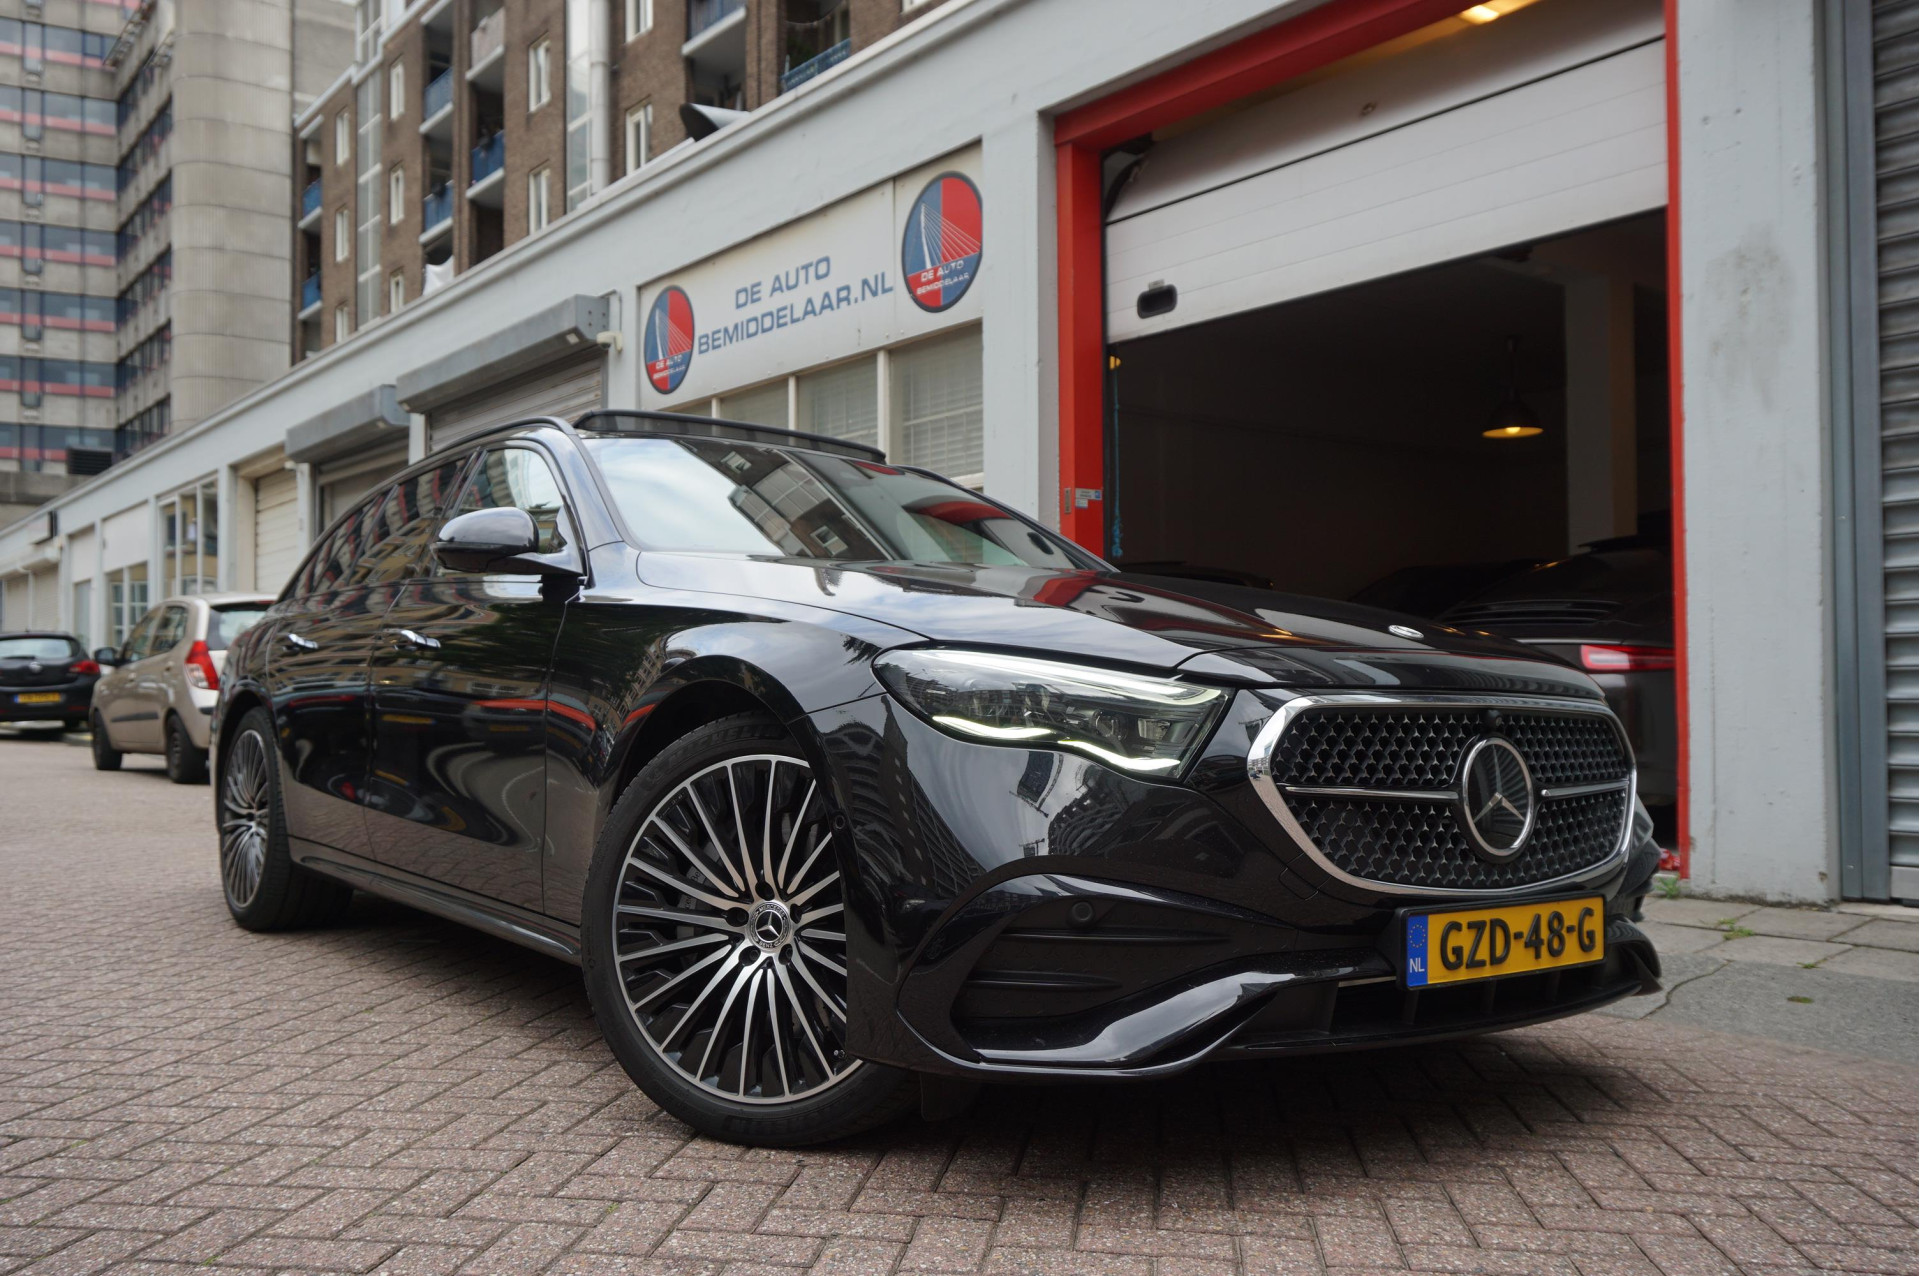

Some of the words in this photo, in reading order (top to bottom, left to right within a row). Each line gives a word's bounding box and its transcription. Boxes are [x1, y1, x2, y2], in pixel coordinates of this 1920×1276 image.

[735, 280, 762, 310] DE
[769, 255, 831, 298] AUTO
[921, 269, 935, 283] DE
[936, 260, 964, 277] AUTO
[916, 272, 970, 295] BEMIDDELAAR
[697, 271, 894, 355] BEMIDDELAAR.NL
[655, 360, 665, 370] DE
[1440, 906, 1596, 971] GZD-48-G
[1409, 956, 1425, 974] NL
